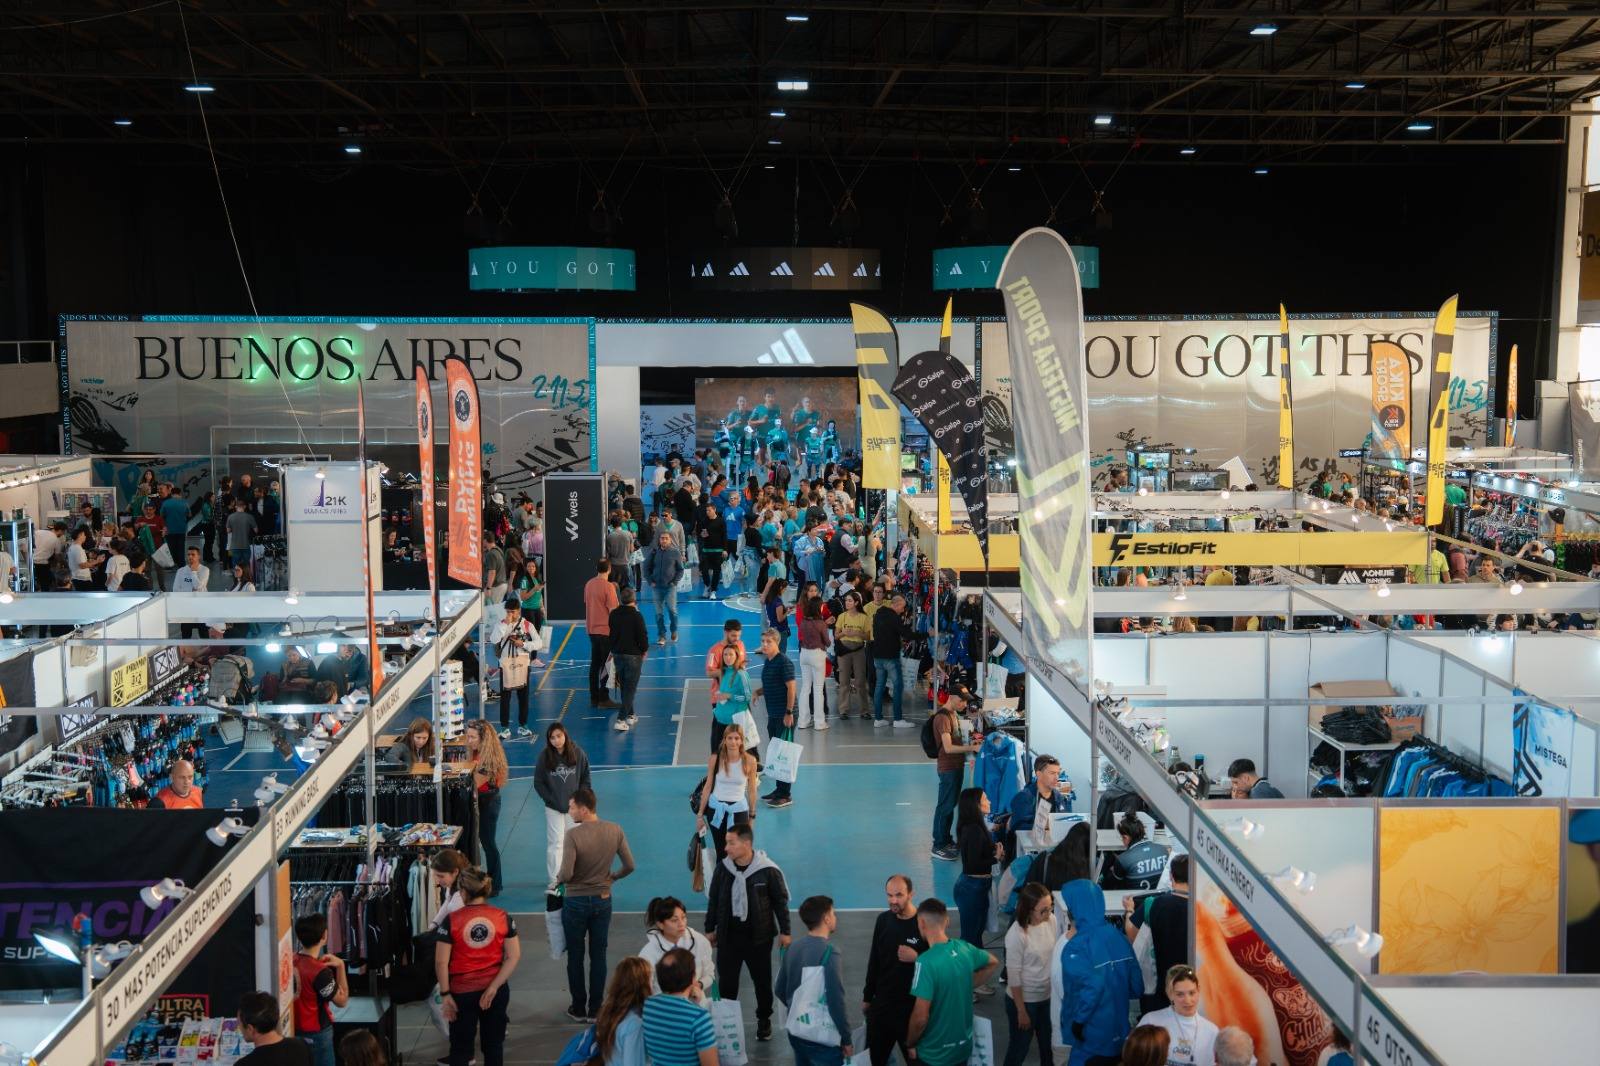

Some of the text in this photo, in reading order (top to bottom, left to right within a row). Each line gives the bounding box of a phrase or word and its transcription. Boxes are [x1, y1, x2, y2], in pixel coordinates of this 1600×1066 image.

[490, 260, 539, 275] YOU
[566, 261, 616, 276] GOT
[134, 336, 523, 382] BUENOS AIRES
[1084, 332, 1424, 379] OU GOT THS
[325, 496, 347, 506] 21K
[1133, 541, 1217, 556] EstiloFit
[1534, 744, 1568, 769] MISTEGA
[107, 872, 233, 1028] 30 MAS POTENCIA SUPLEMENTOS
[1367, 1015, 1380, 1045] 46
